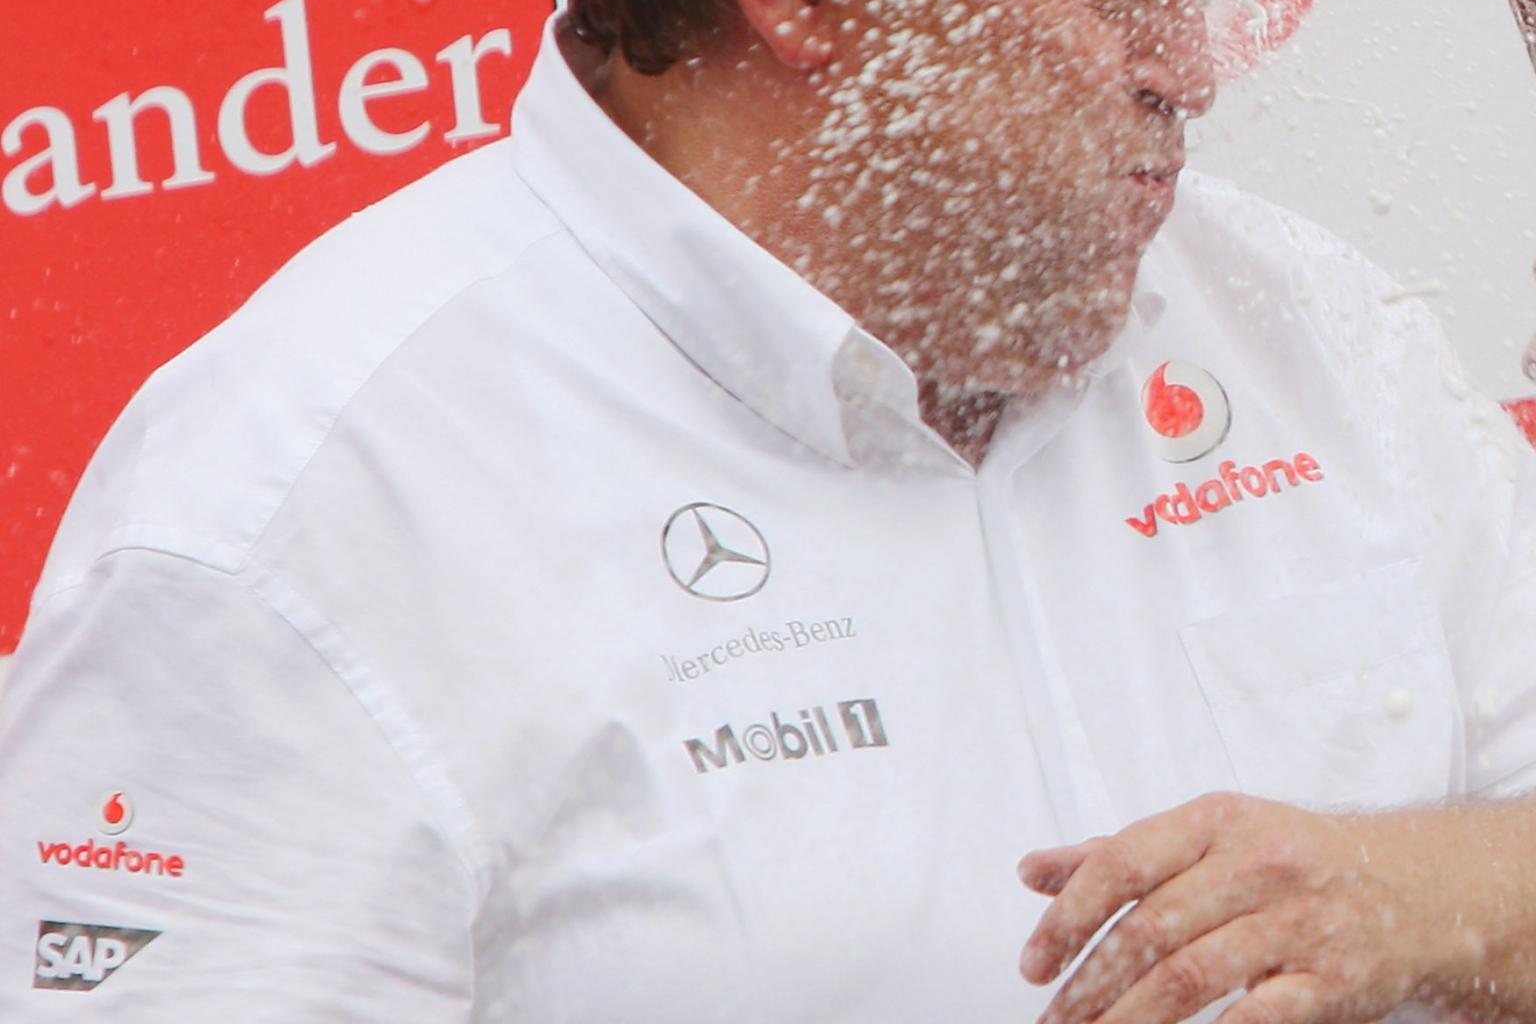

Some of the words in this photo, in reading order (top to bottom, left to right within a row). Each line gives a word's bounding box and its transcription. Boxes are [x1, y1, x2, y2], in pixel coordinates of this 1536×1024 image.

[1125, 450, 1325, 538] vodafone
[682, 705, 840, 775] Mobil
[37, 838, 185, 878] vodafone
[36, 931, 128, 982] SAP
